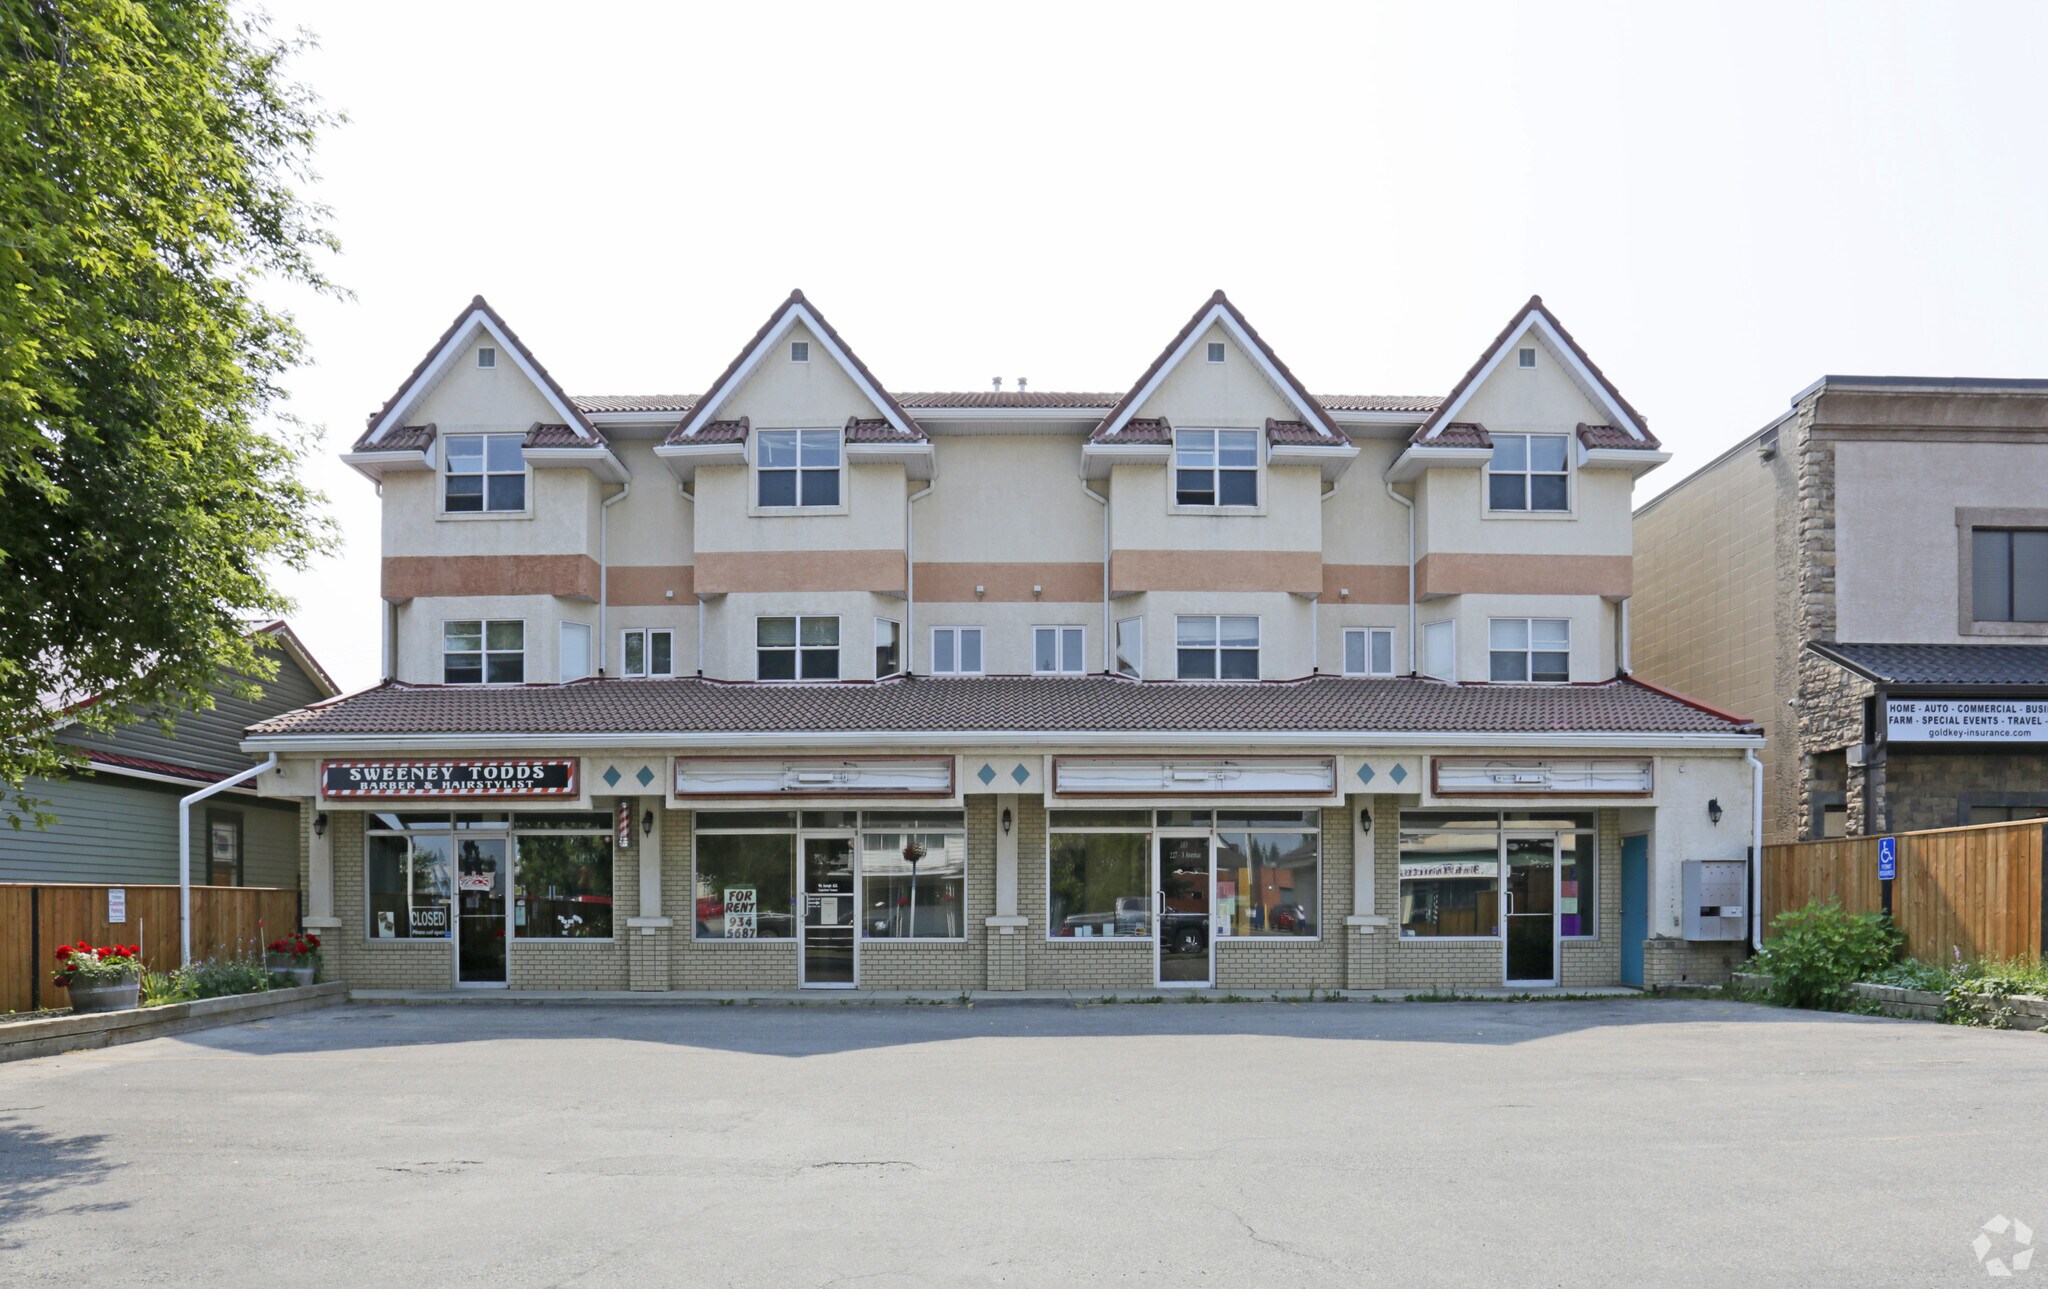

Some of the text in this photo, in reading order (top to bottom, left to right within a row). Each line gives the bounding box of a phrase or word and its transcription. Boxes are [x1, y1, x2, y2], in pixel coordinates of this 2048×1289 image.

[1890, 704, 1916, 713] HOME
[1924, 704, 1948, 713] AUTO
[1957, 704, 2016, 714] COMMERCIAL
[2026, 704, 2048, 714] BUSI
[1888, 716, 1913, 724] FARM
[1922, 716, 1960, 725] SPECIAL
[1963, 716, 1998, 725] EVENTS
[2008, 716, 2042, 725] TRAVEL
[1928, 728, 2032, 738] goldkey-insurance.com
[349, 766, 545, 780] SWEENEY TODDS
[360, 780, 534, 790] BARBER & HAIRSTYLIST
[728, 890, 753, 901] FOR
[725, 902, 756, 913] RENT
[411, 911, 445, 926] CLOSED
[730, 916, 752, 927] 934
[726, 928, 756, 938] 5687
